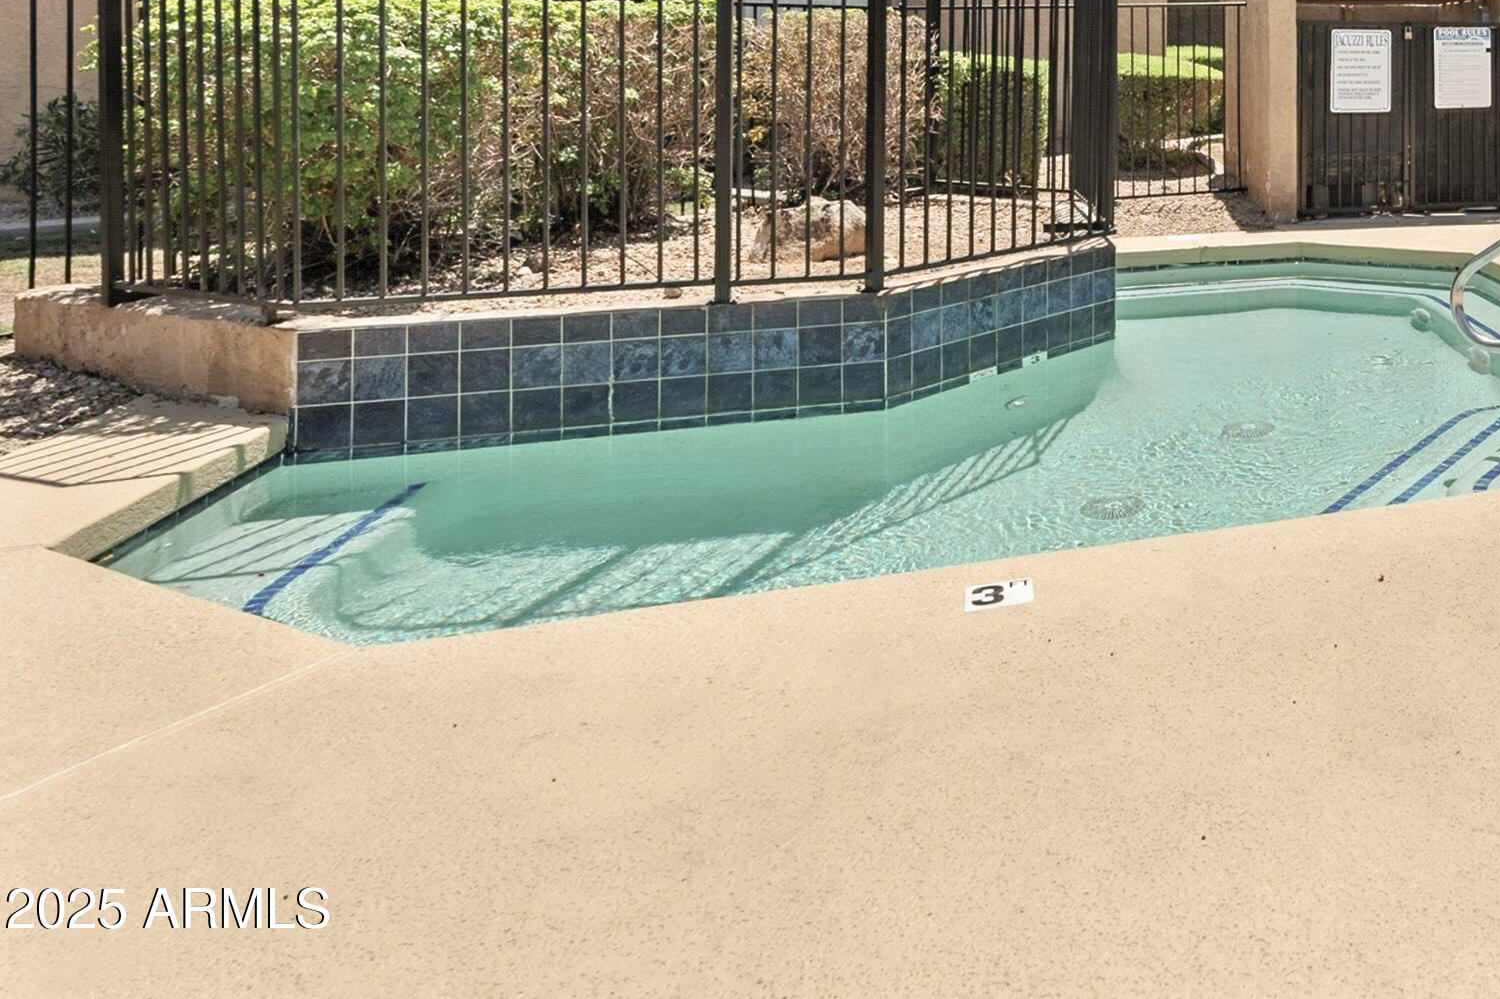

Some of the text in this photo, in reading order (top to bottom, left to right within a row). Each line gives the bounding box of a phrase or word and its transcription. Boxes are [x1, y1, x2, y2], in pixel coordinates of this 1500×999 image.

[1335, 34, 1389, 48] JACUZZI RULES
[971, 585, 1004, 606] 3
